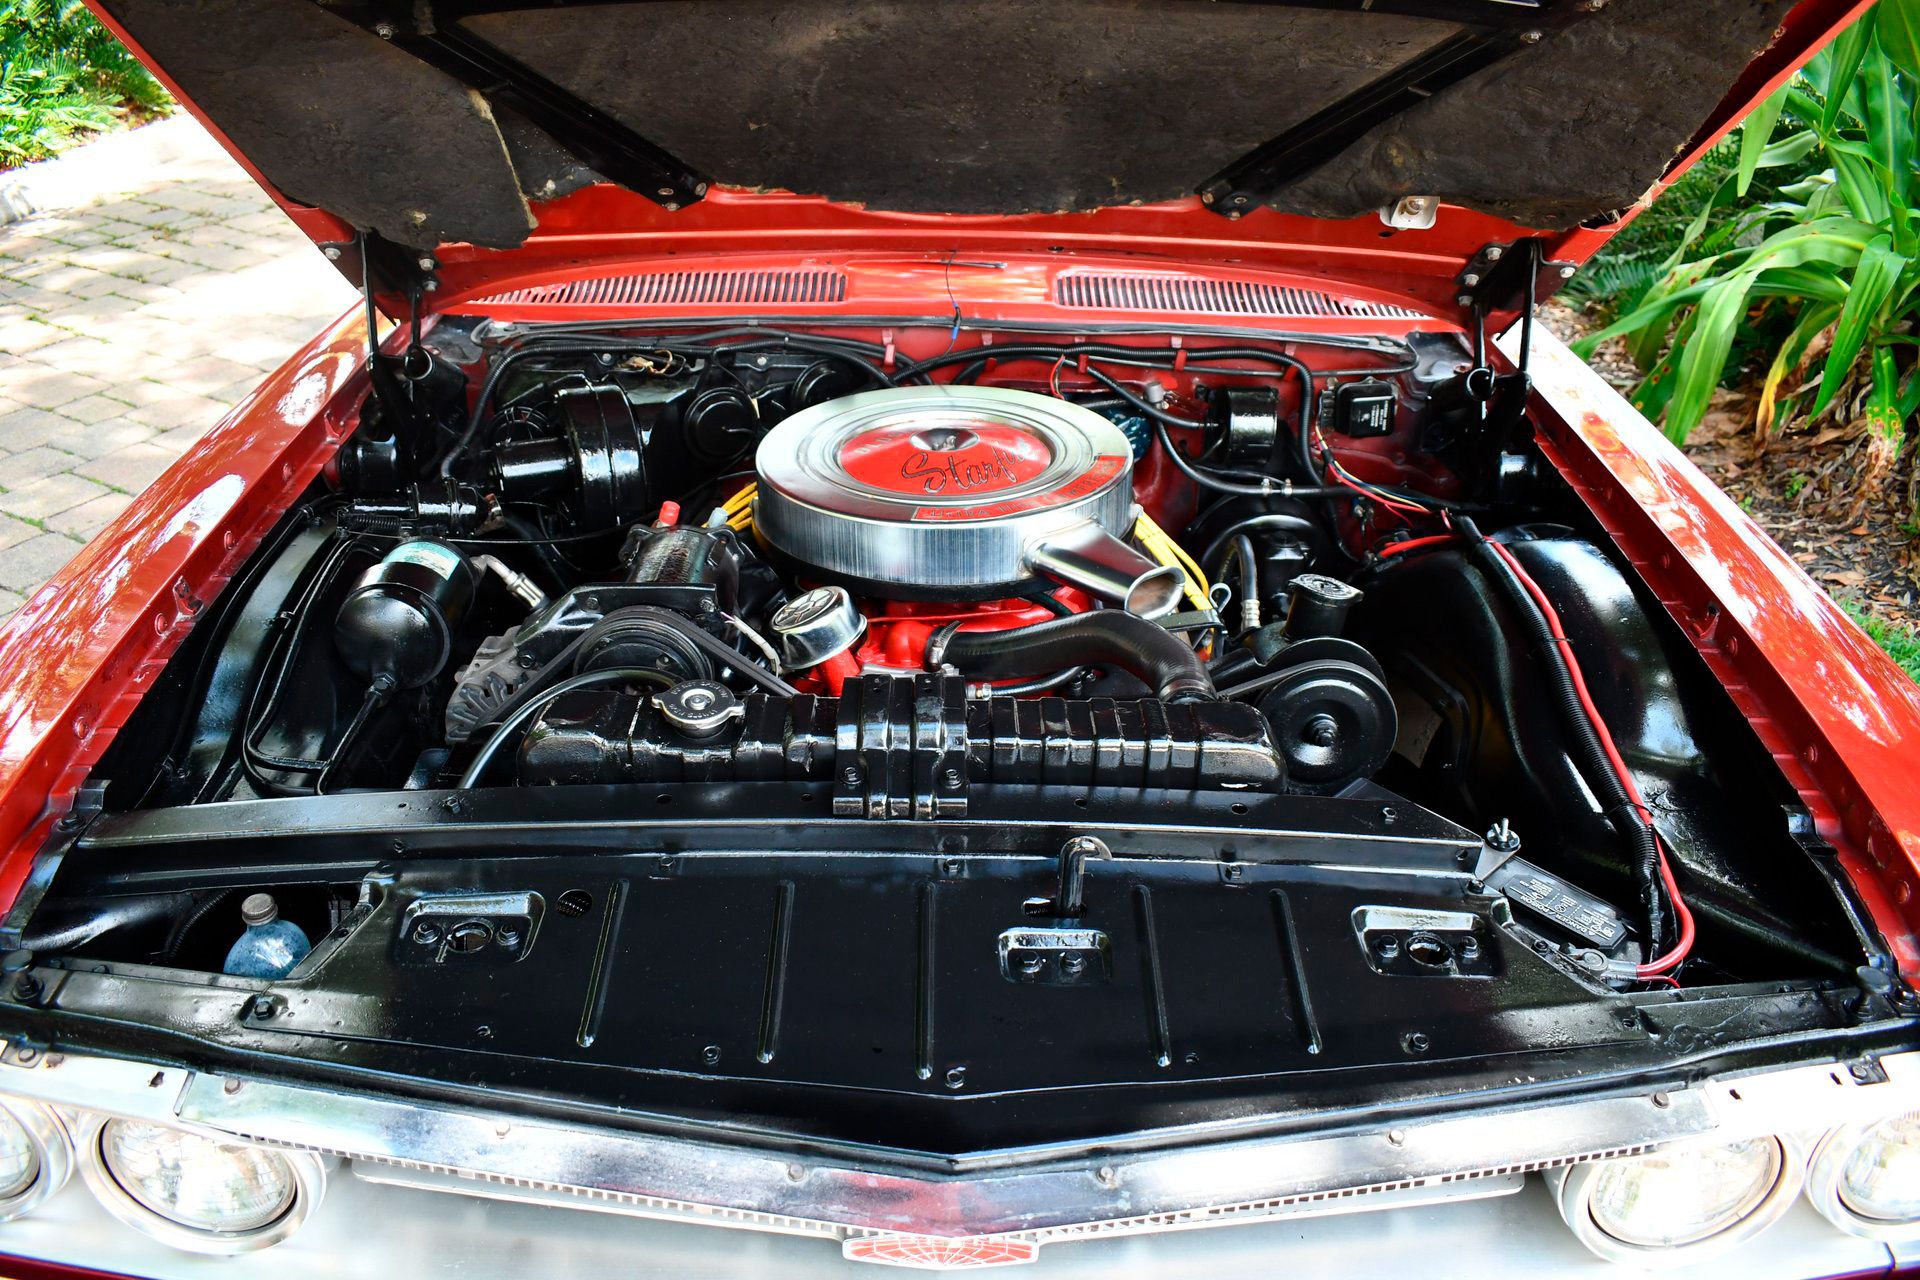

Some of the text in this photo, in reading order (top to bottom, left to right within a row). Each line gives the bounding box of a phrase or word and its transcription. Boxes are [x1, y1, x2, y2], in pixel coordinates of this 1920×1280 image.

[902, 439, 1035, 494] Starfir
[1520, 895, 1549, 913] POISON
[1556, 914, 1588, 933] DANGER
